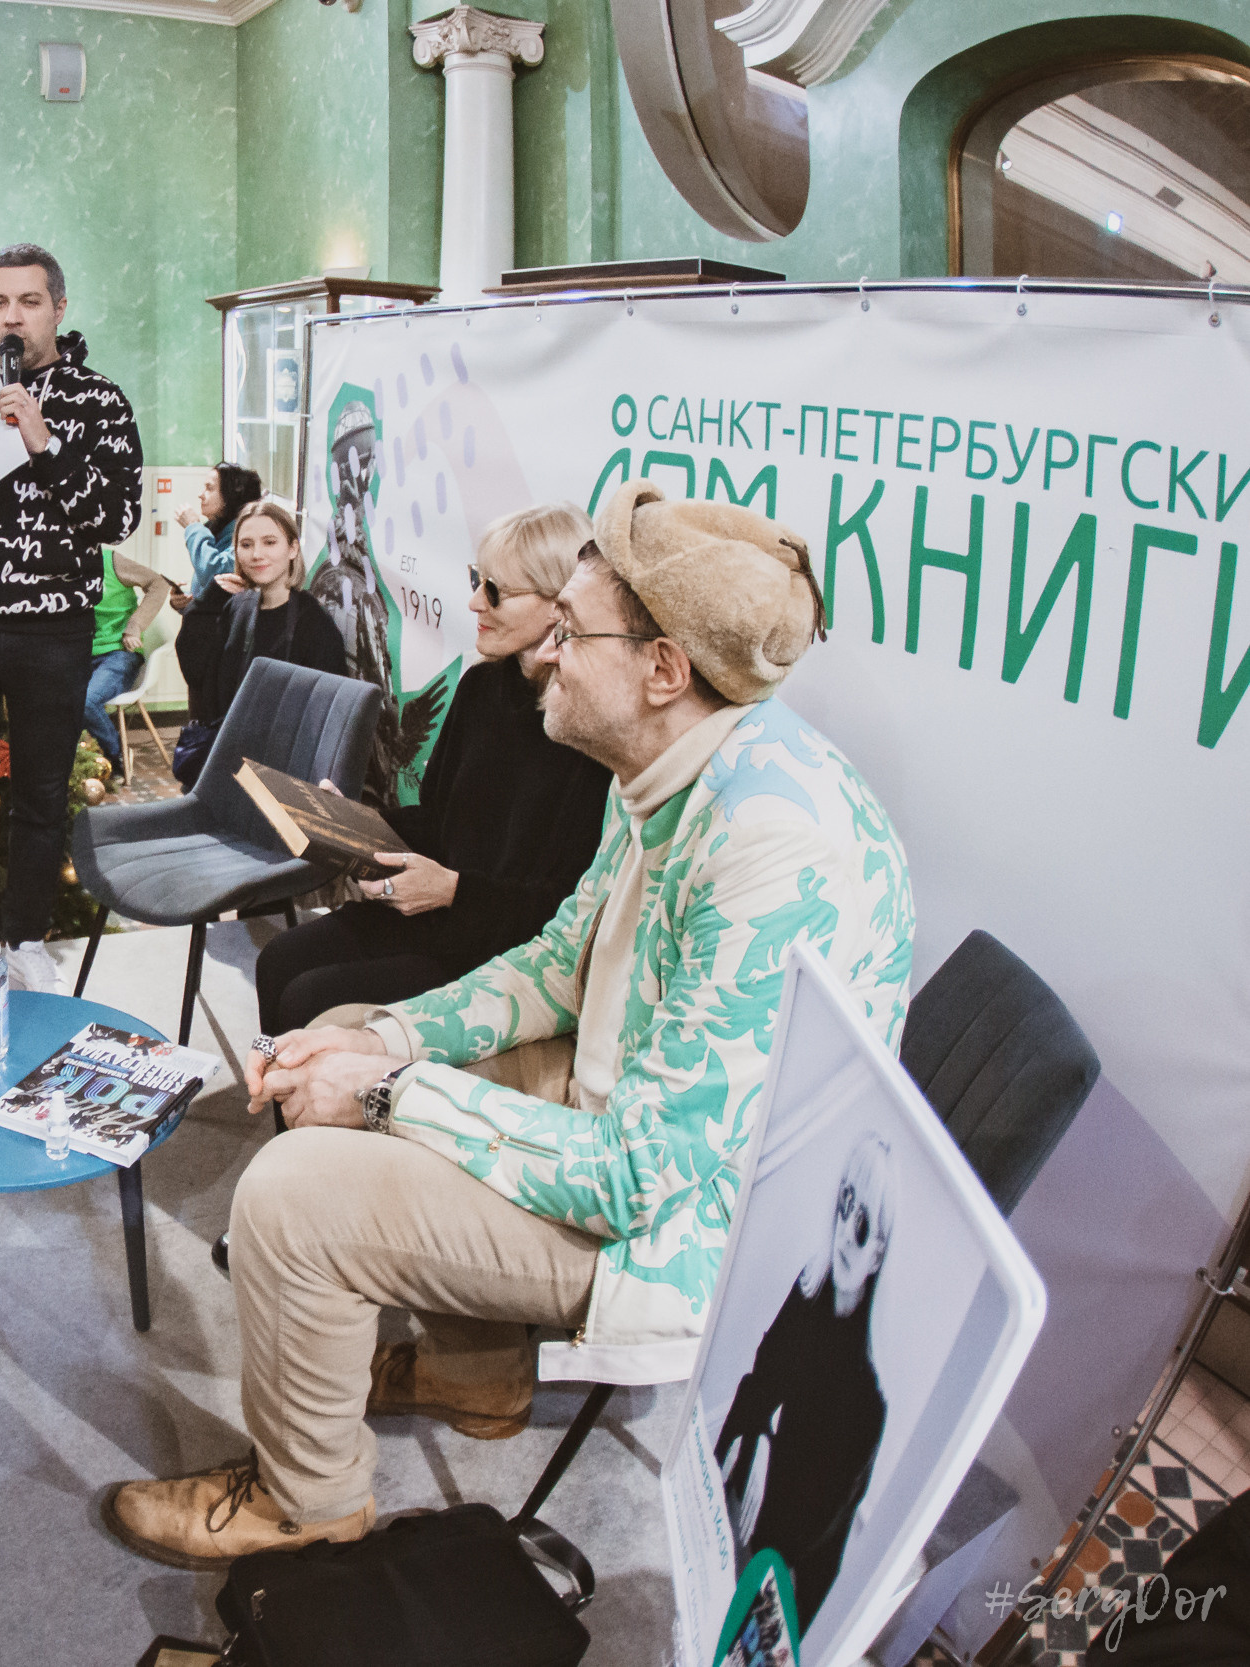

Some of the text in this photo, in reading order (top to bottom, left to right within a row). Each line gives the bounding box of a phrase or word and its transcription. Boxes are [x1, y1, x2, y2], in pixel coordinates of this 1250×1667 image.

[400, 554, 418, 575] EST.
[401, 586, 443, 630] 1919
[41, 1063, 171, 1118] РОК
[128, 1069, 188, 1095] КОНЕЦ
